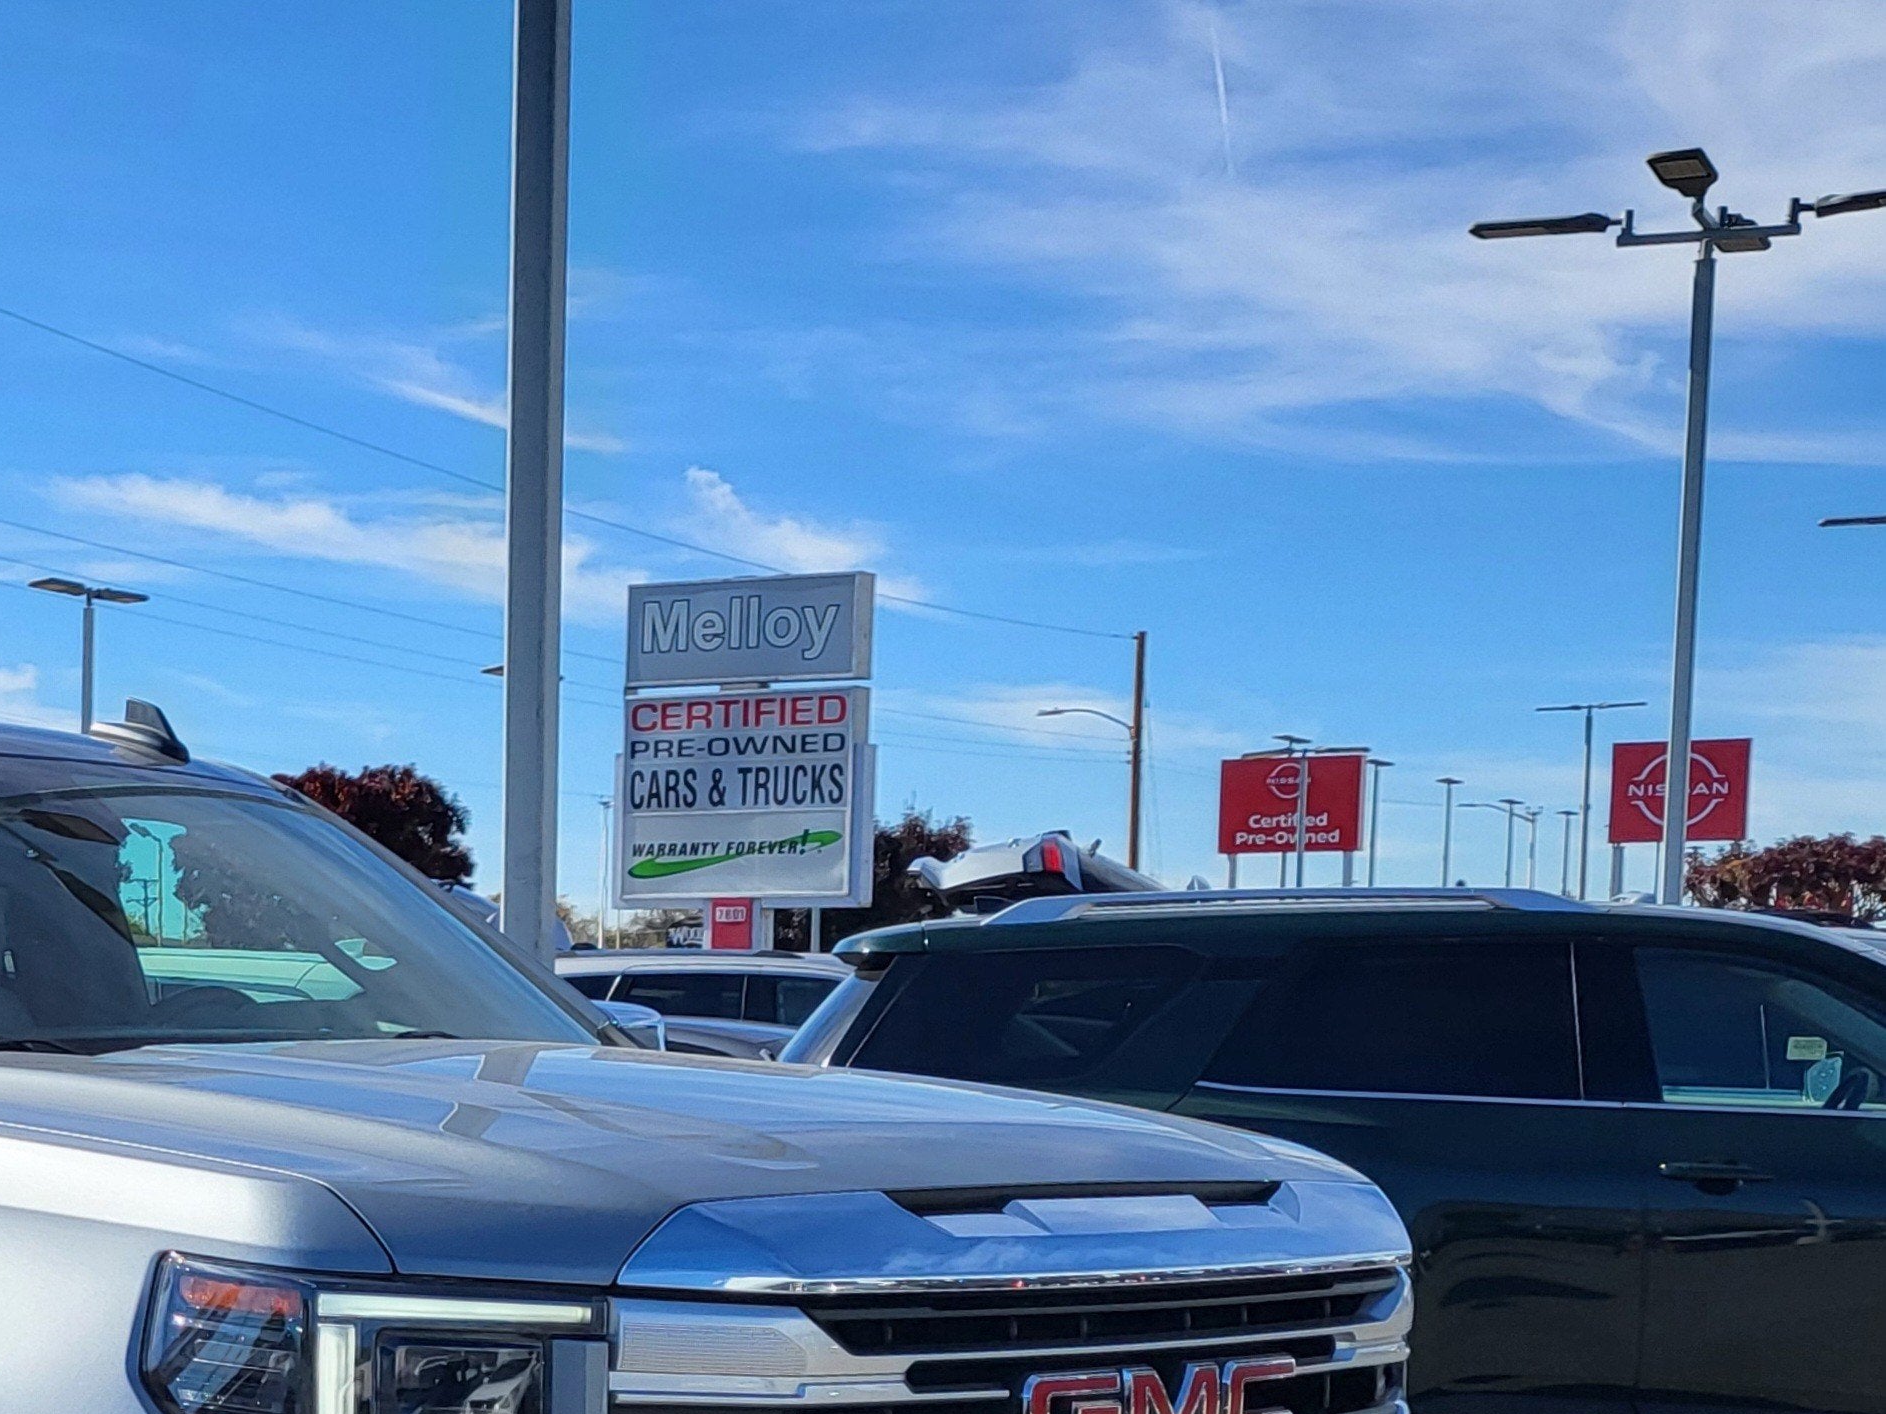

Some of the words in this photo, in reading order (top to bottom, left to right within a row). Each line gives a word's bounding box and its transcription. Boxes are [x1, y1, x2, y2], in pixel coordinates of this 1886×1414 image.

[641, 594, 841, 661] Melloy
[630, 694, 848, 733] CERTIFIED
[629, 732, 846, 760] PRE-OWNED
[630, 767, 698, 810] CARS
[708, 767, 727, 807] &
[737, 762, 845, 807] TRUCKS
[1627, 781, 1729, 797] NISAN
[1248, 811, 1329, 829] Certifed
[632, 841, 720, 858] WARRANTY
[725, 829, 811, 856] FOREVER!
